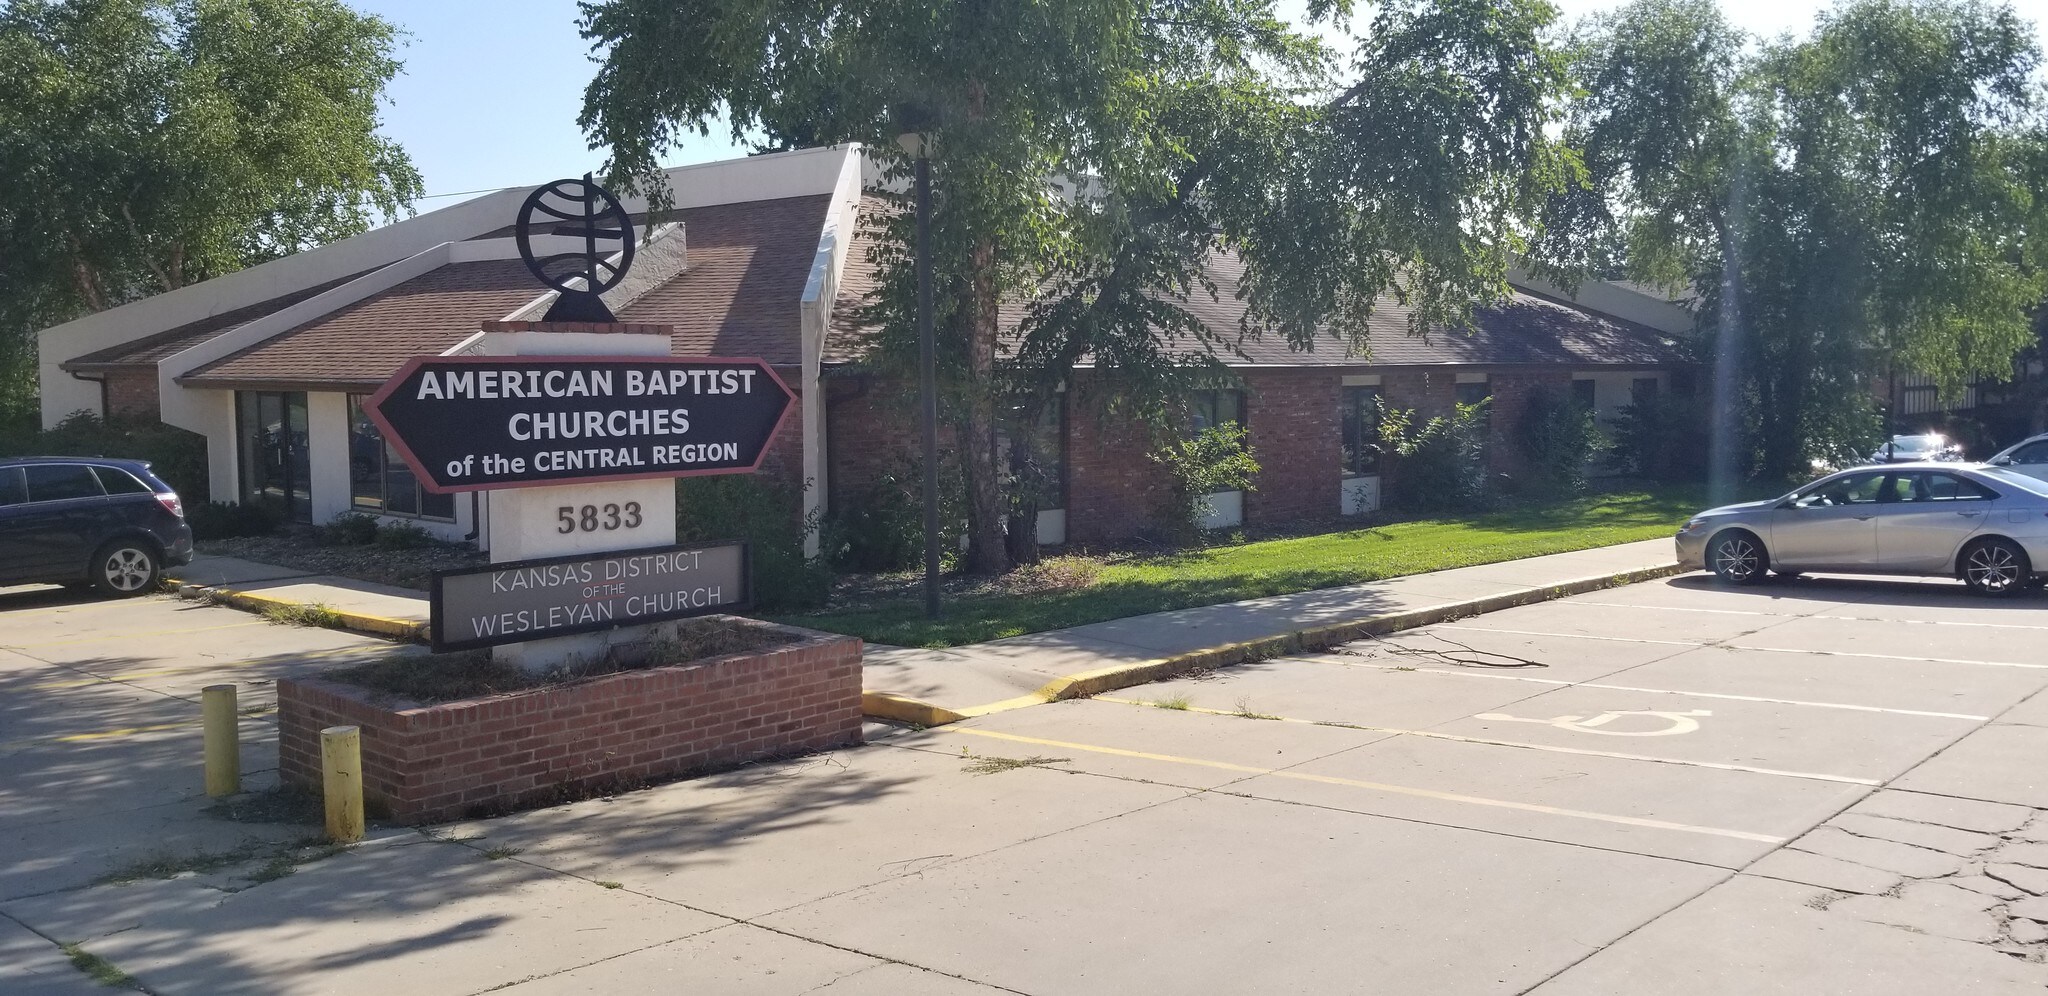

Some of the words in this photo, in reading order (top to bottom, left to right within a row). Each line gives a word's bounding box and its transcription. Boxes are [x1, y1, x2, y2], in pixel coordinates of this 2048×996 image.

[416, 370, 613, 400] AMERICAN
[626, 369, 756, 396] BAPTIST
[508, 408, 690, 441] CHURCHES
[446, 454, 474, 477] of
[482, 453, 526, 475] the
[534, 447, 645, 472] CENTRAL
[653, 442, 738, 465] REGION
[558, 502, 643, 534] 5833
[492, 562, 593, 594] KANSAS
[605, 551, 703, 581] DISTRICT
[582, 585, 599, 598] OF
[603, 583, 626, 596] THE
[471, 600, 613, 638] WESLEYAN
[626, 586, 722, 617] CHURCH
